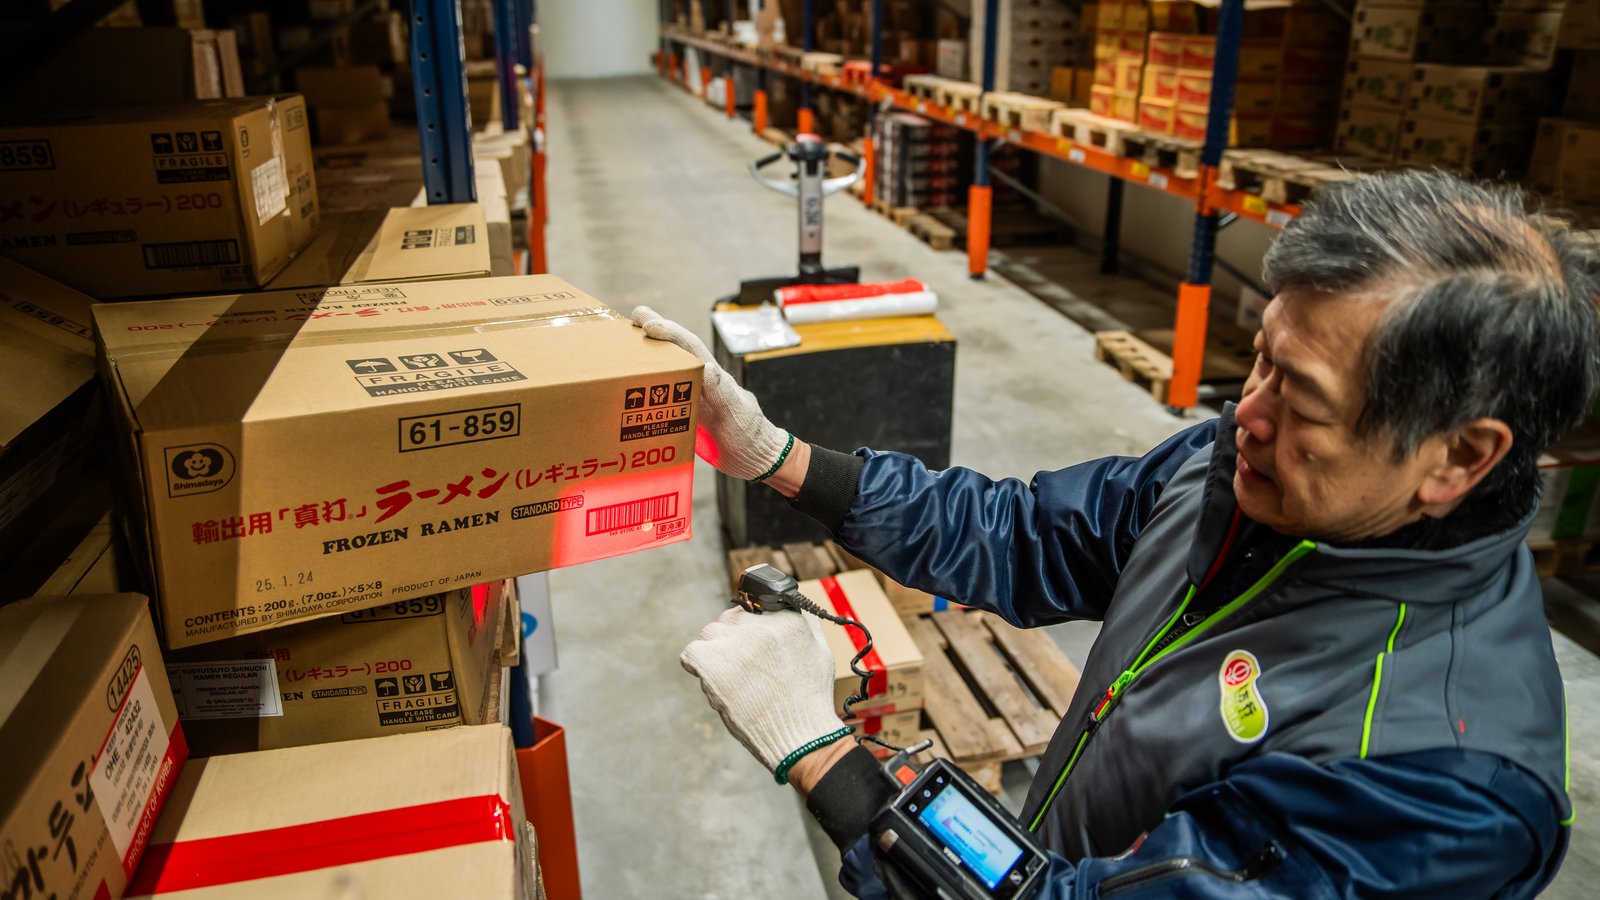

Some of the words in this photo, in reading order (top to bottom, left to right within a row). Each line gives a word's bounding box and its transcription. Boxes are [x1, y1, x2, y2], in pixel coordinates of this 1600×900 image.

[159, 155, 224, 169] FRAGILE
[176, 192, 223, 211] 200
[369, 364, 505, 385] FRAGILE
[417, 376, 475, 387] PLEASE
[375, 385, 435, 397] HANDLE
[441, 380, 479, 390] WITH
[482, 375, 522, 385] CARE
[626, 407, 688, 425] FRAGILE
[409, 410, 515, 445] 61-859
[622, 430, 650, 440] HANDLE
[652, 427, 668, 436] WITH
[669, 425, 687, 433] CARE
[643, 422, 669, 431] PLEASE
[631, 445, 676, 468] 200
[174, 479, 224, 490] Shimadaya
[322, 527, 410, 555] FROZEN
[421, 510, 501, 537] RAMEN
[512, 502, 559, 519] STANDARD
[559, 496, 583, 510] TYPE
[392, 580, 434, 595] PRODUCT
[439, 577, 451, 585] OF
[454, 571, 482, 582] JAPAN
[185, 617, 258, 638] MANUFACTURED
[262, 613, 273, 622] BY
[276, 604, 323, 619] SHIMADAYA
[326, 591, 383, 608] CORPORATION
[375, 659, 412, 674] 200
[111, 649, 139, 705] 14425
[312, 688, 348, 698] STANDARD
[383, 695, 453, 710] FRAGILE
[383, 716, 414, 725] HANDLE
[436, 711, 457, 719] CARE
[404, 709, 434, 717] PLEASE
[106, 731, 117, 755] KEEP
[117, 699, 132, 732] FROZEN
[105, 747, 121, 780] OHE
[125, 700, 142, 735] 42432
[128, 808, 153, 870] PRODUCT
[150, 792, 159, 812] OF
[155, 756, 173, 796] KOREA
